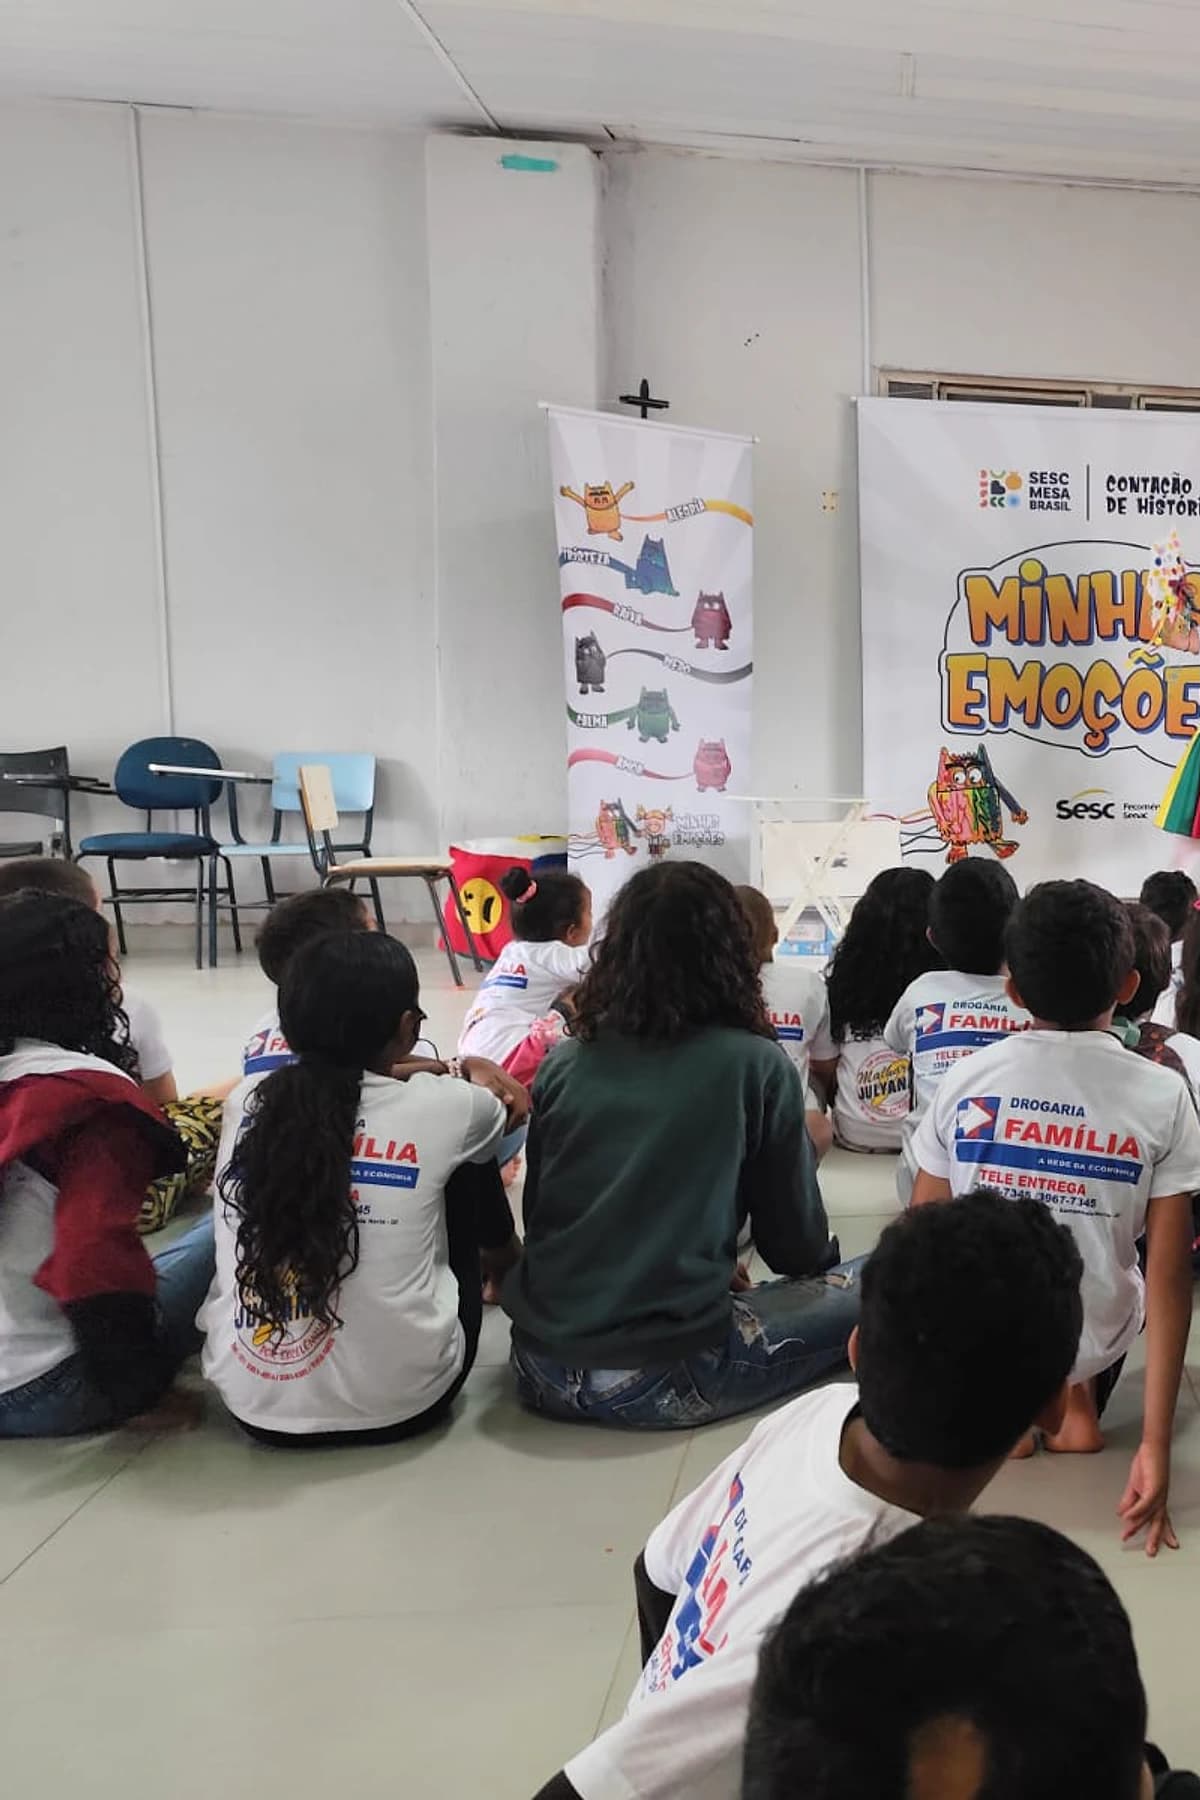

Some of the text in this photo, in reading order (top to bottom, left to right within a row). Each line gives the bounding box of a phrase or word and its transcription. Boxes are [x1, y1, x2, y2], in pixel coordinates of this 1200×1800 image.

[1029, 471, 1070, 485] SESC
[1106, 472, 1192, 497] CONTAÇÃO
[1029, 487, 1070, 499] MESA
[1029, 501, 1071, 512] BRASIL
[1106, 497, 1127, 515] DE
[1056, 799, 1116, 820] Sesc
[1010, 1097, 1085, 1118] DROGARIA
[1004, 1118, 1140, 1160] FAMÍLIA
[979, 1169, 1087, 1196] TELE ENTREGA
